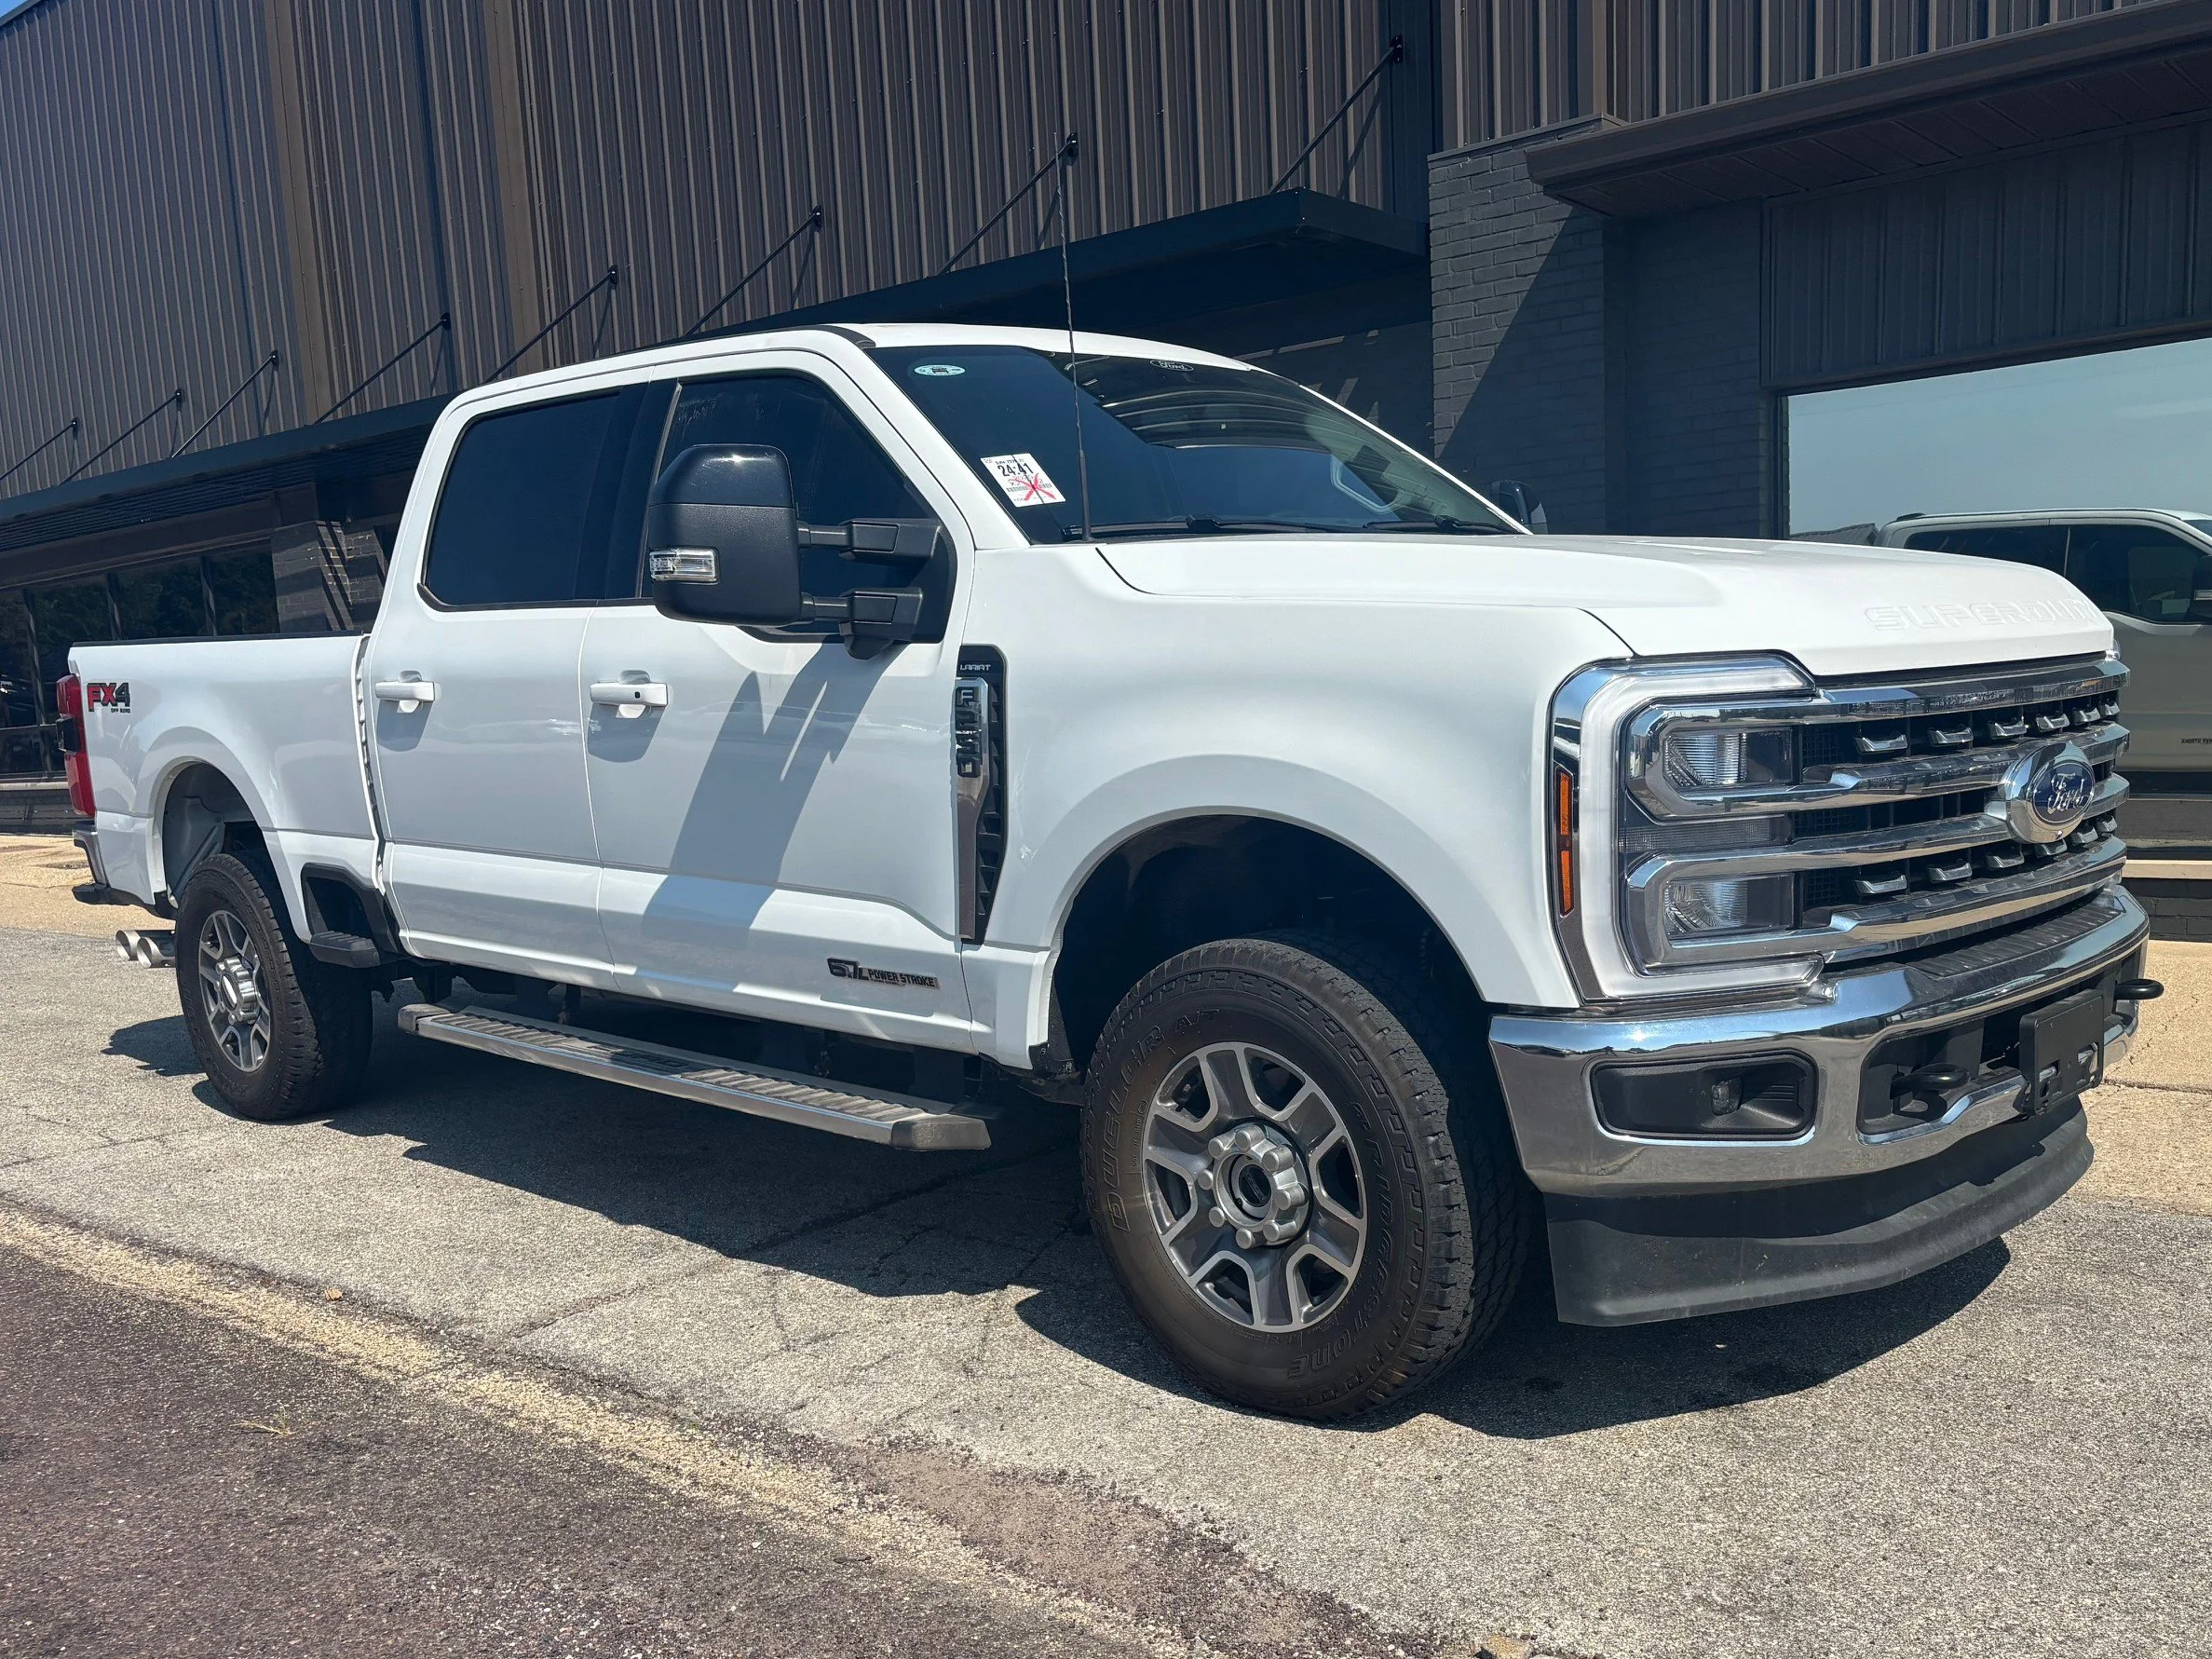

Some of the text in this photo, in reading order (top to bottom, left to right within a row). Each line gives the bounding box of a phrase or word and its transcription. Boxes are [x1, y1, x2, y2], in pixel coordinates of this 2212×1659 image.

[1864, 605, 2029, 632] SUPER
[87, 682, 130, 712] FX4
[2047, 772, 2085, 814] Ford
[868, 969, 899, 983] POWER
[899, 972, 935, 987] STROKE
